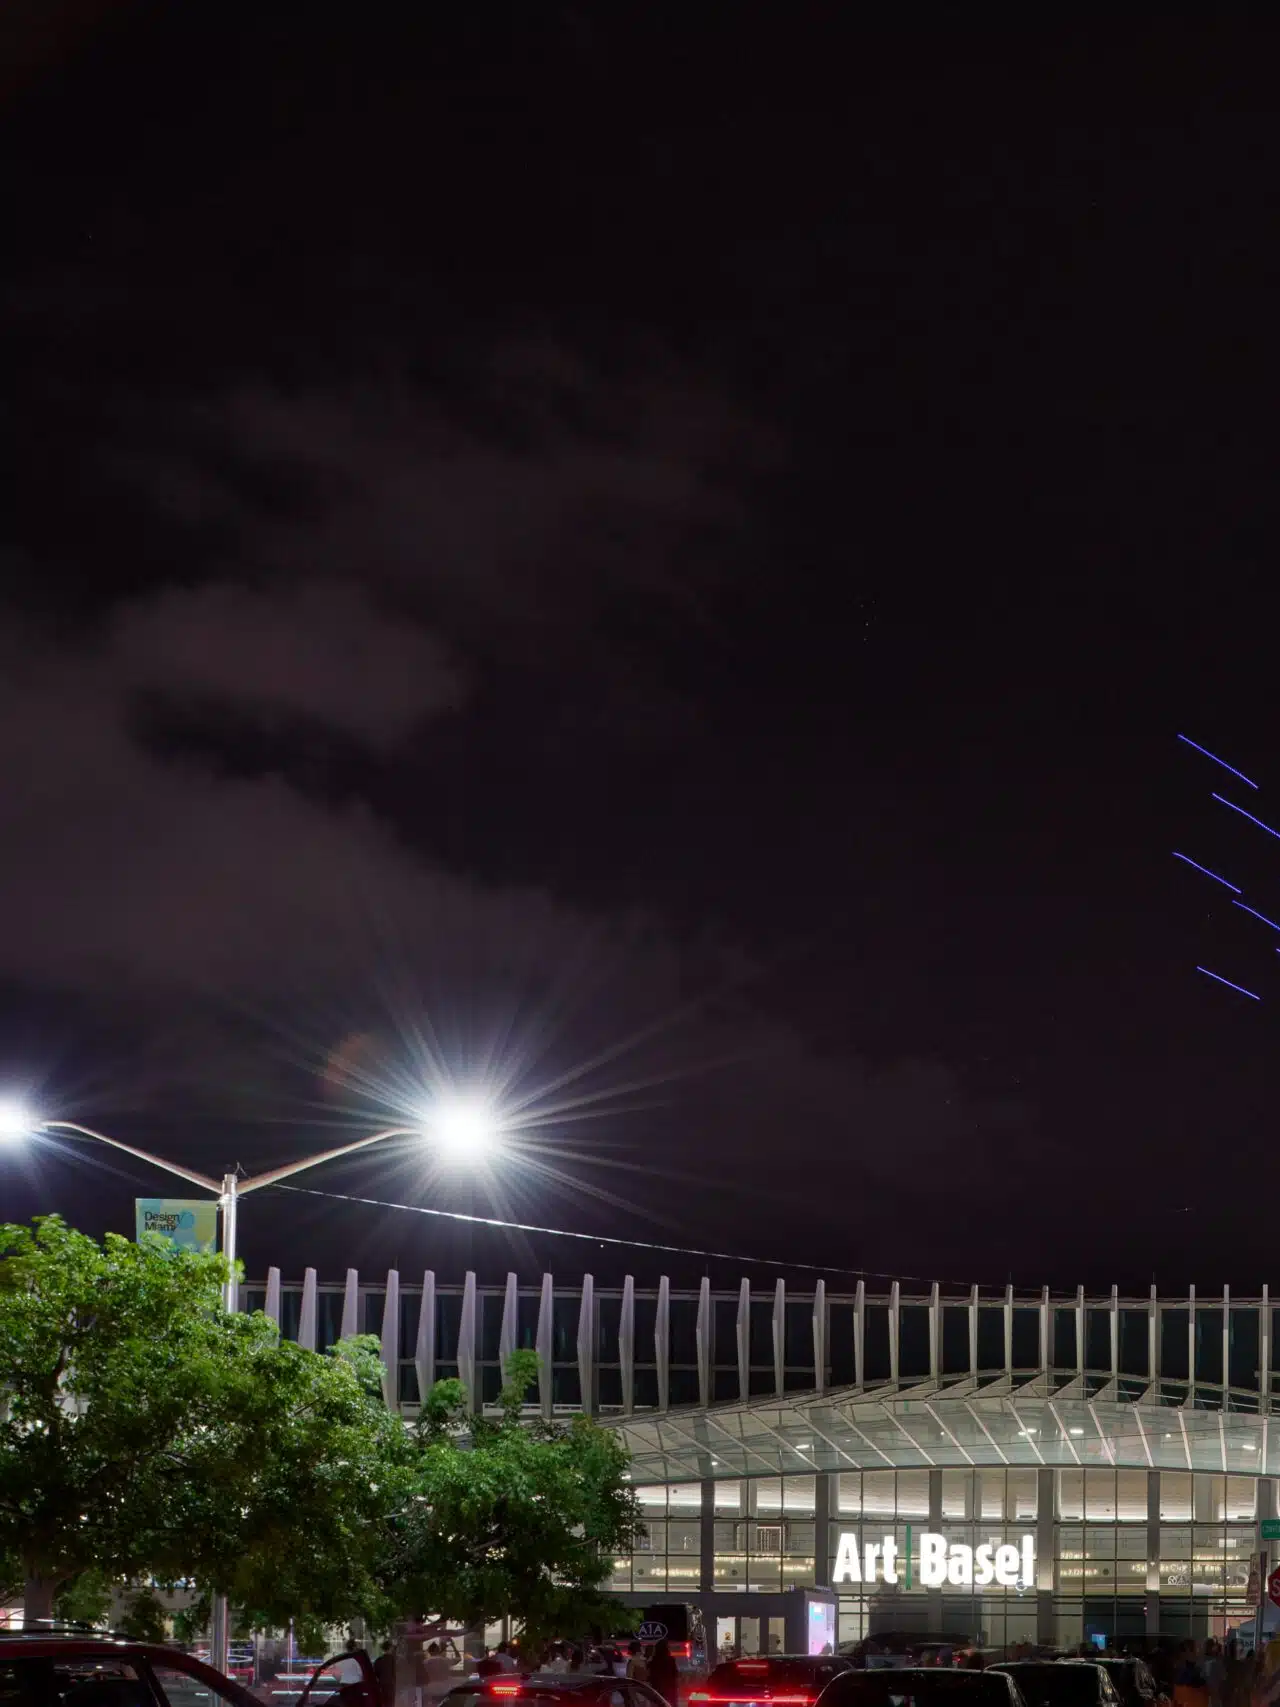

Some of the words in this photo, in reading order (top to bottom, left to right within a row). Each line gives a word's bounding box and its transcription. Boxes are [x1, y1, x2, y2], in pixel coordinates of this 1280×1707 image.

[144, 1211, 180, 1225] Design
[832, 1532, 898, 1584] Art
[919, 1532, 1034, 1587] Basel
[638, 1623, 662, 1635] A1A
